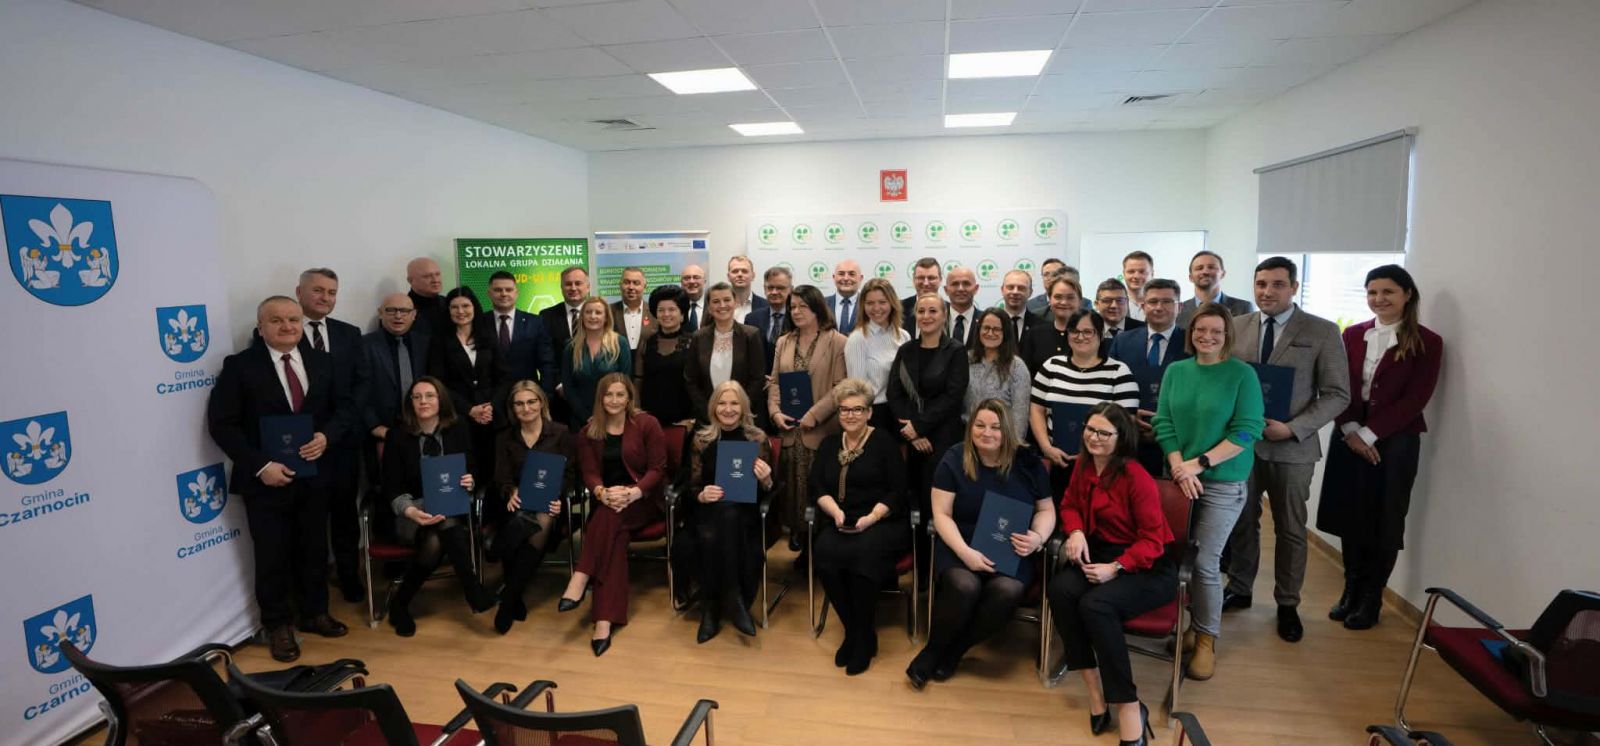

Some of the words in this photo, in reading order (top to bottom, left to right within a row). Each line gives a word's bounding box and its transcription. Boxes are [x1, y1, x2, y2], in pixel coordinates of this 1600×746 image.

[465, 244, 583, 258] STOWARZYSZENIE
[465, 260, 506, 269] LOKALNA
[510, 258, 539, 268] GRUPA
[541, 257, 584, 266] DZIAŁANIA
[156, 374, 217, 394] Czarnoci
[175, 369, 205, 380] Gmina
[21, 488, 65, 506] Gmina
[0, 492, 90, 527] Czarnocin
[194, 525, 223, 541] Gmina
[177, 528, 241, 559] Czarnocin
[49, 674, 83, 695] Gmin
[24, 682, 90, 720] Czarno
